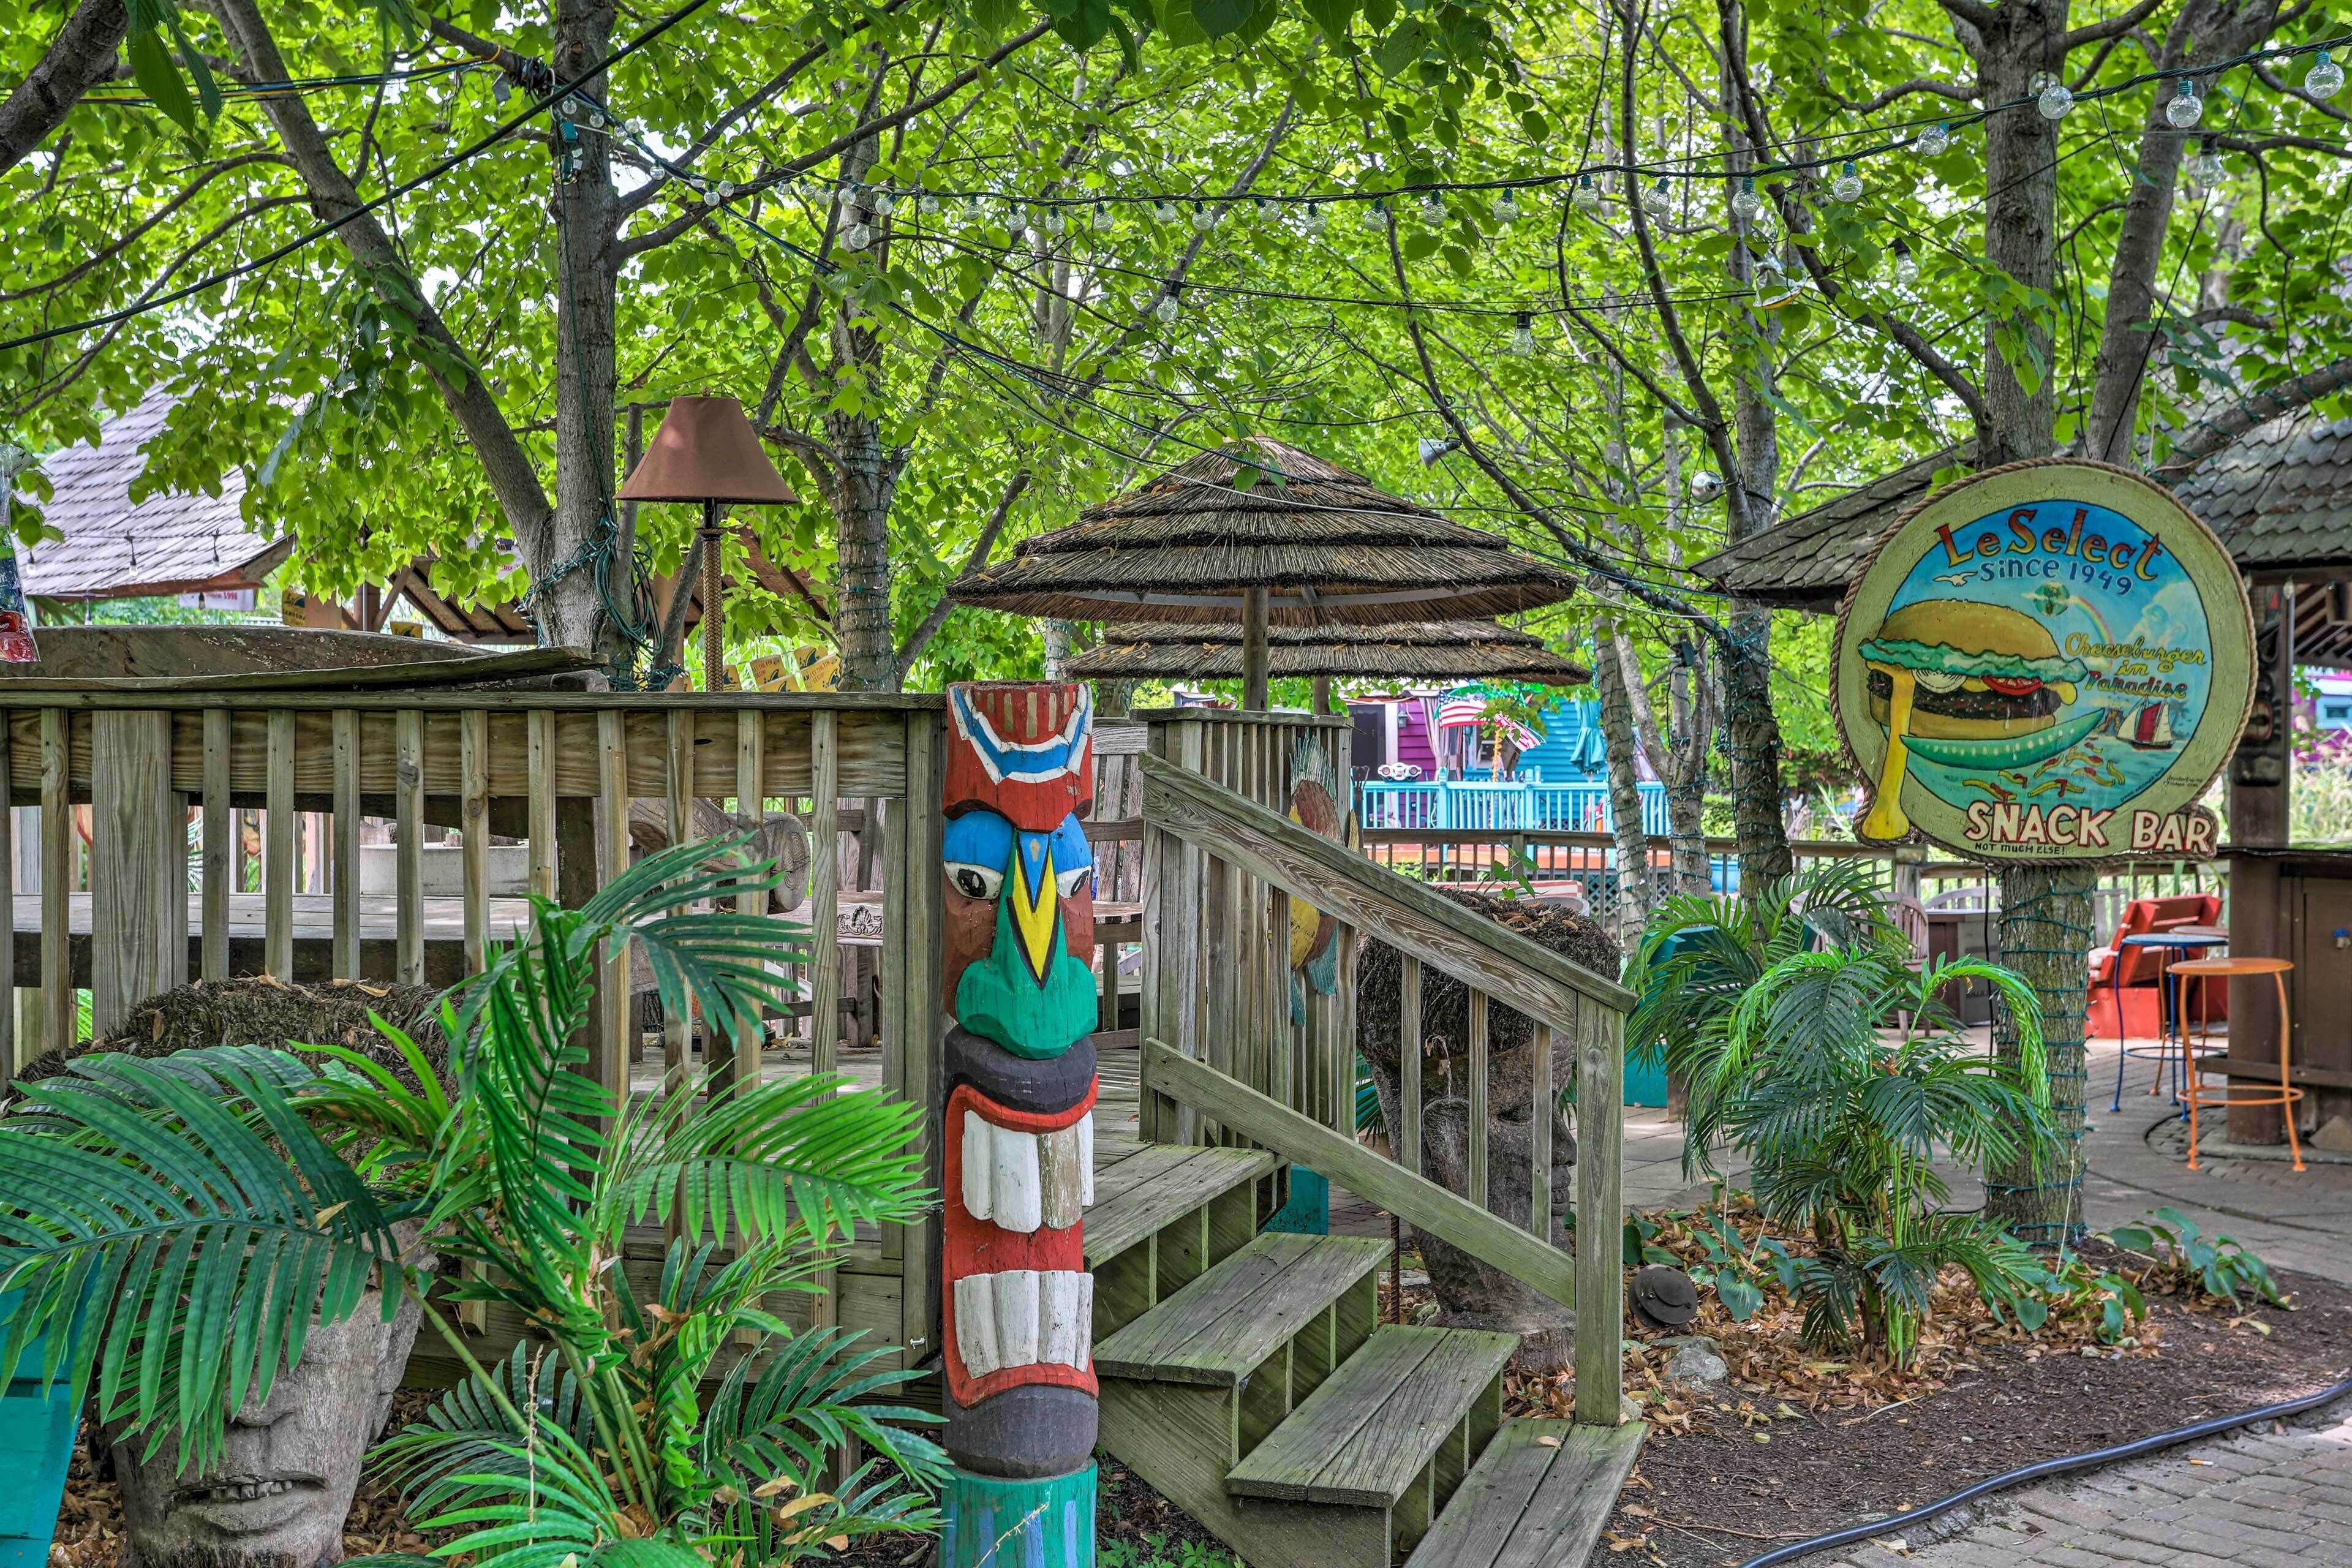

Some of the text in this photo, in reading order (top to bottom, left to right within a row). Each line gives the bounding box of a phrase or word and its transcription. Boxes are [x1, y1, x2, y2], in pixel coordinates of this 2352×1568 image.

[2069, 562, 2133, 596] 1949
[2065, 632, 2207, 673] Cheeseburger
[2114, 659, 2149, 676] in
[2084, 670, 2188, 699] Paradise
[1963, 801, 2212, 854] SNACK BAR
[1974, 842, 1997, 852] NOT
[2036, 845, 2067, 856] ELSE!
